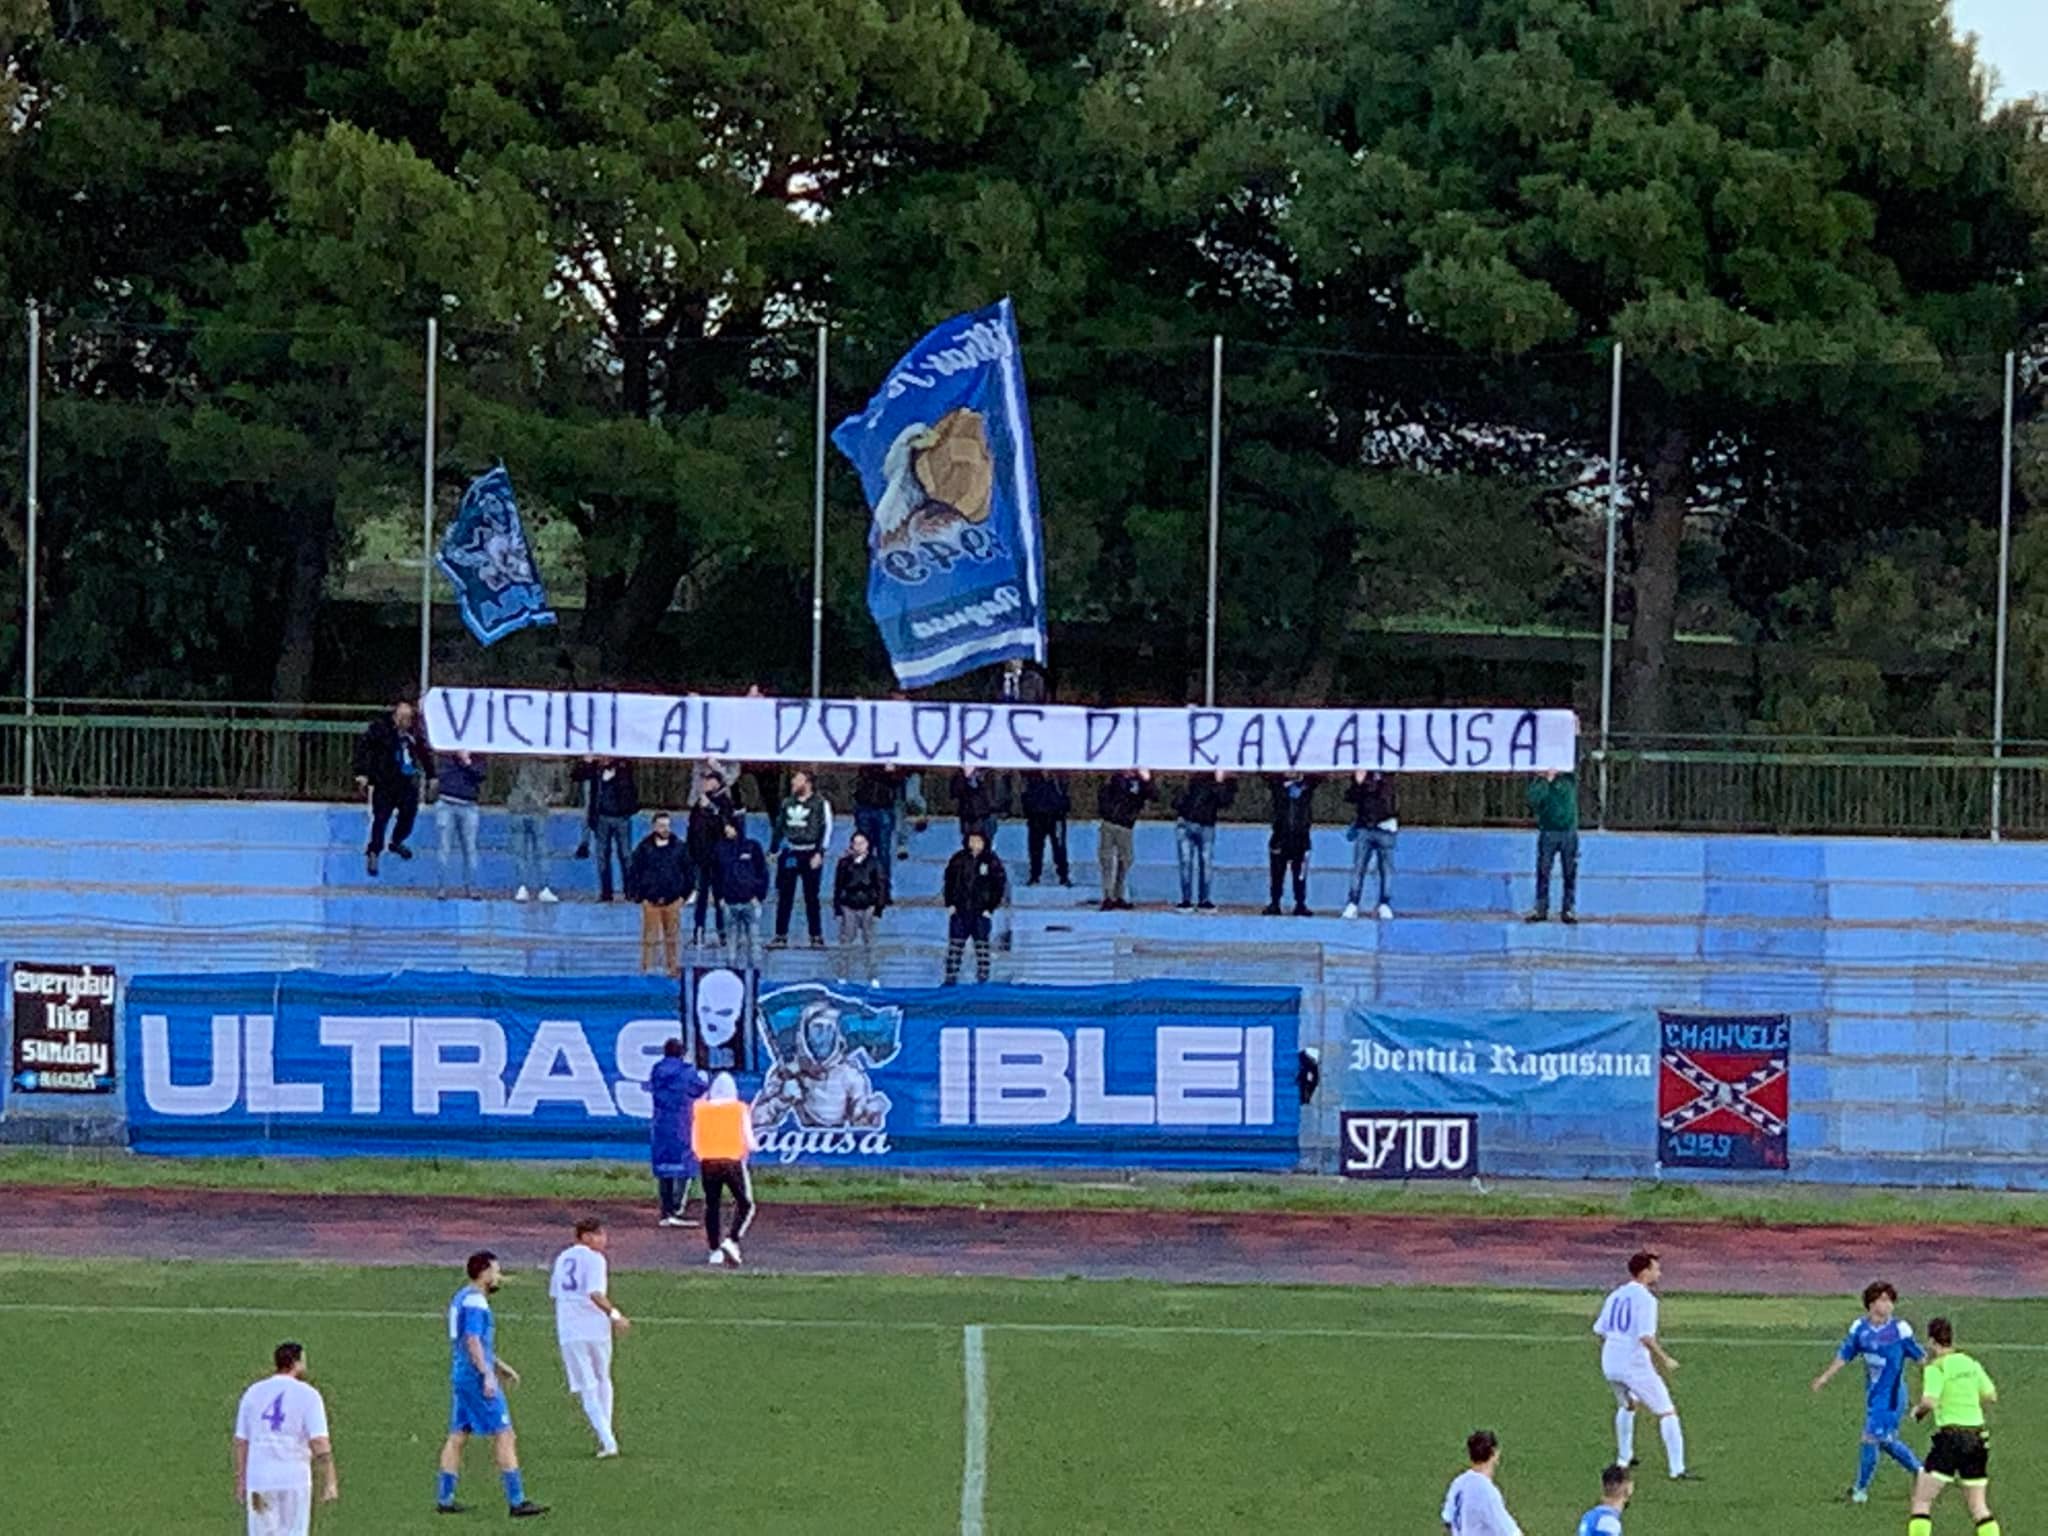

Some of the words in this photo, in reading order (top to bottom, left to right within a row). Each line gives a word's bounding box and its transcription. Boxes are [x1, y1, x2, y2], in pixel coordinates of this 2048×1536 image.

[441, 690, 618, 750] VICINI
[659, 700, 730, 753] AL
[775, 701, 1045, 764] DOLORE
[1086, 708, 1140, 765] DI
[1189, 711, 1538, 767] RAVANUSA
[14, 965, 115, 1005] everyday
[46, 1002, 90, 1030] like
[21, 1031, 109, 1075] sunday
[1348, 1037, 1477, 1074] Identità
[1488, 1044, 1652, 1083] Ragusana
[940, 1026, 1274, 1125] IBLEI
[752, 1130, 892, 1163] agusa
[1346, 1117, 1471, 1171] 97100
[560, 1257, 578, 1292] 3
[1608, 1296, 1633, 1333] 10
[260, 1391, 287, 1432] 4
